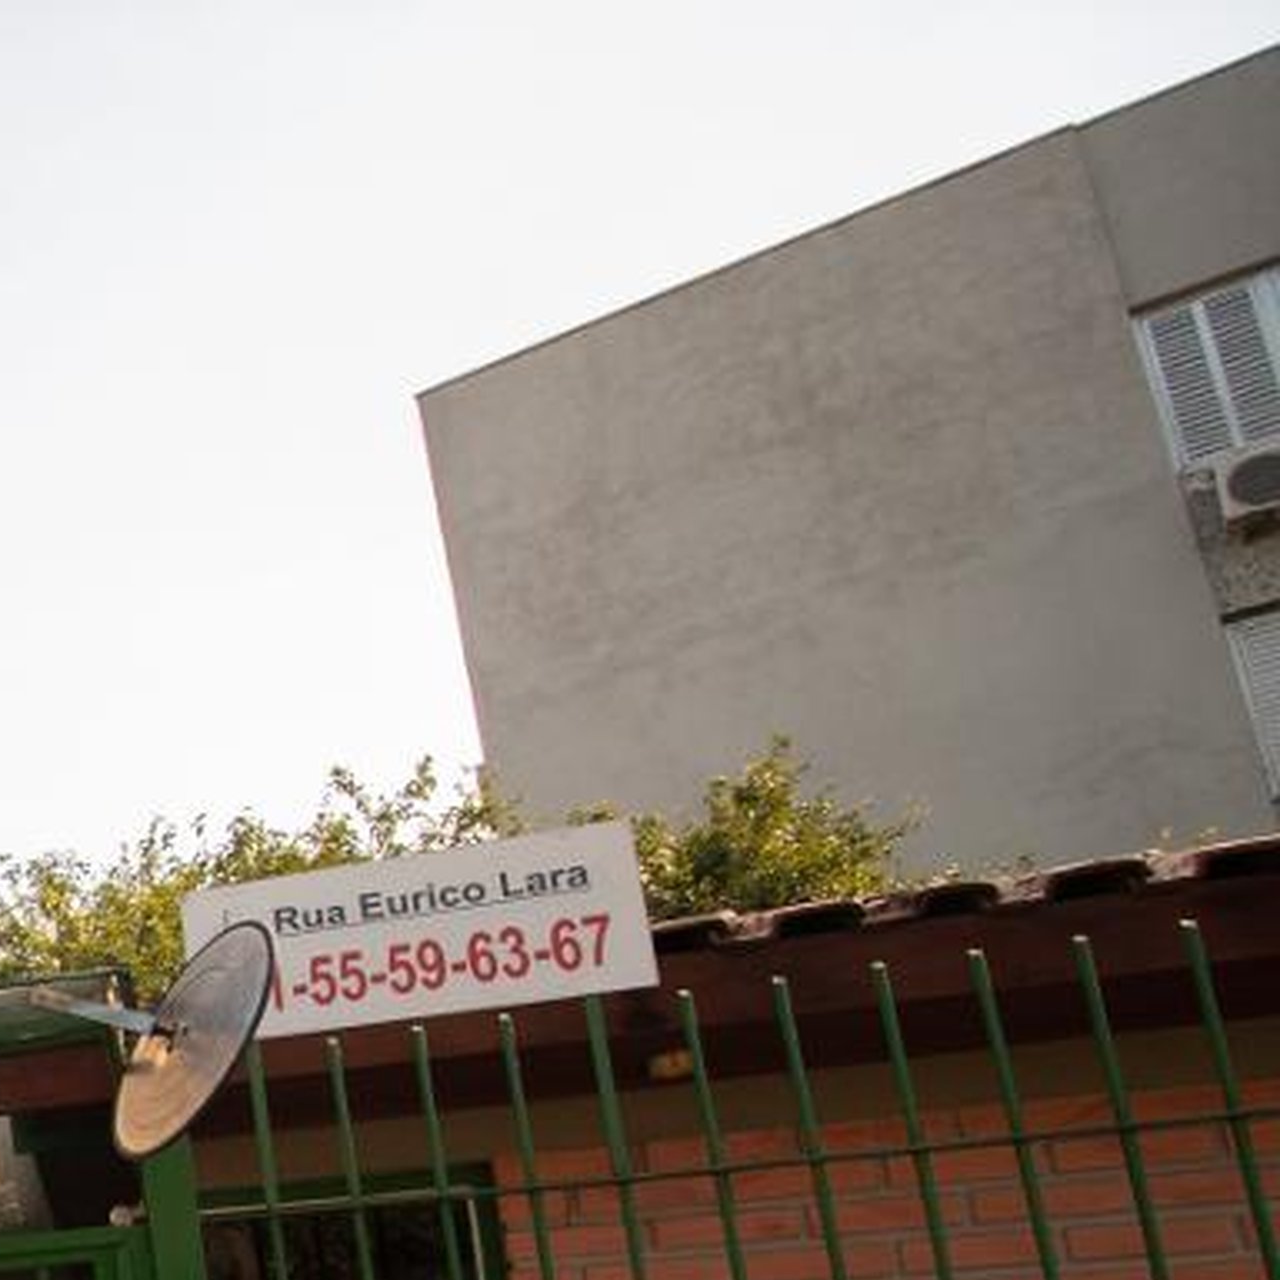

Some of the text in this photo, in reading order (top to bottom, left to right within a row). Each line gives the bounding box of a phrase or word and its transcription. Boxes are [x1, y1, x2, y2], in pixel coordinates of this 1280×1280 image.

[274, 864, 589, 934] Rua Eurico Lara
